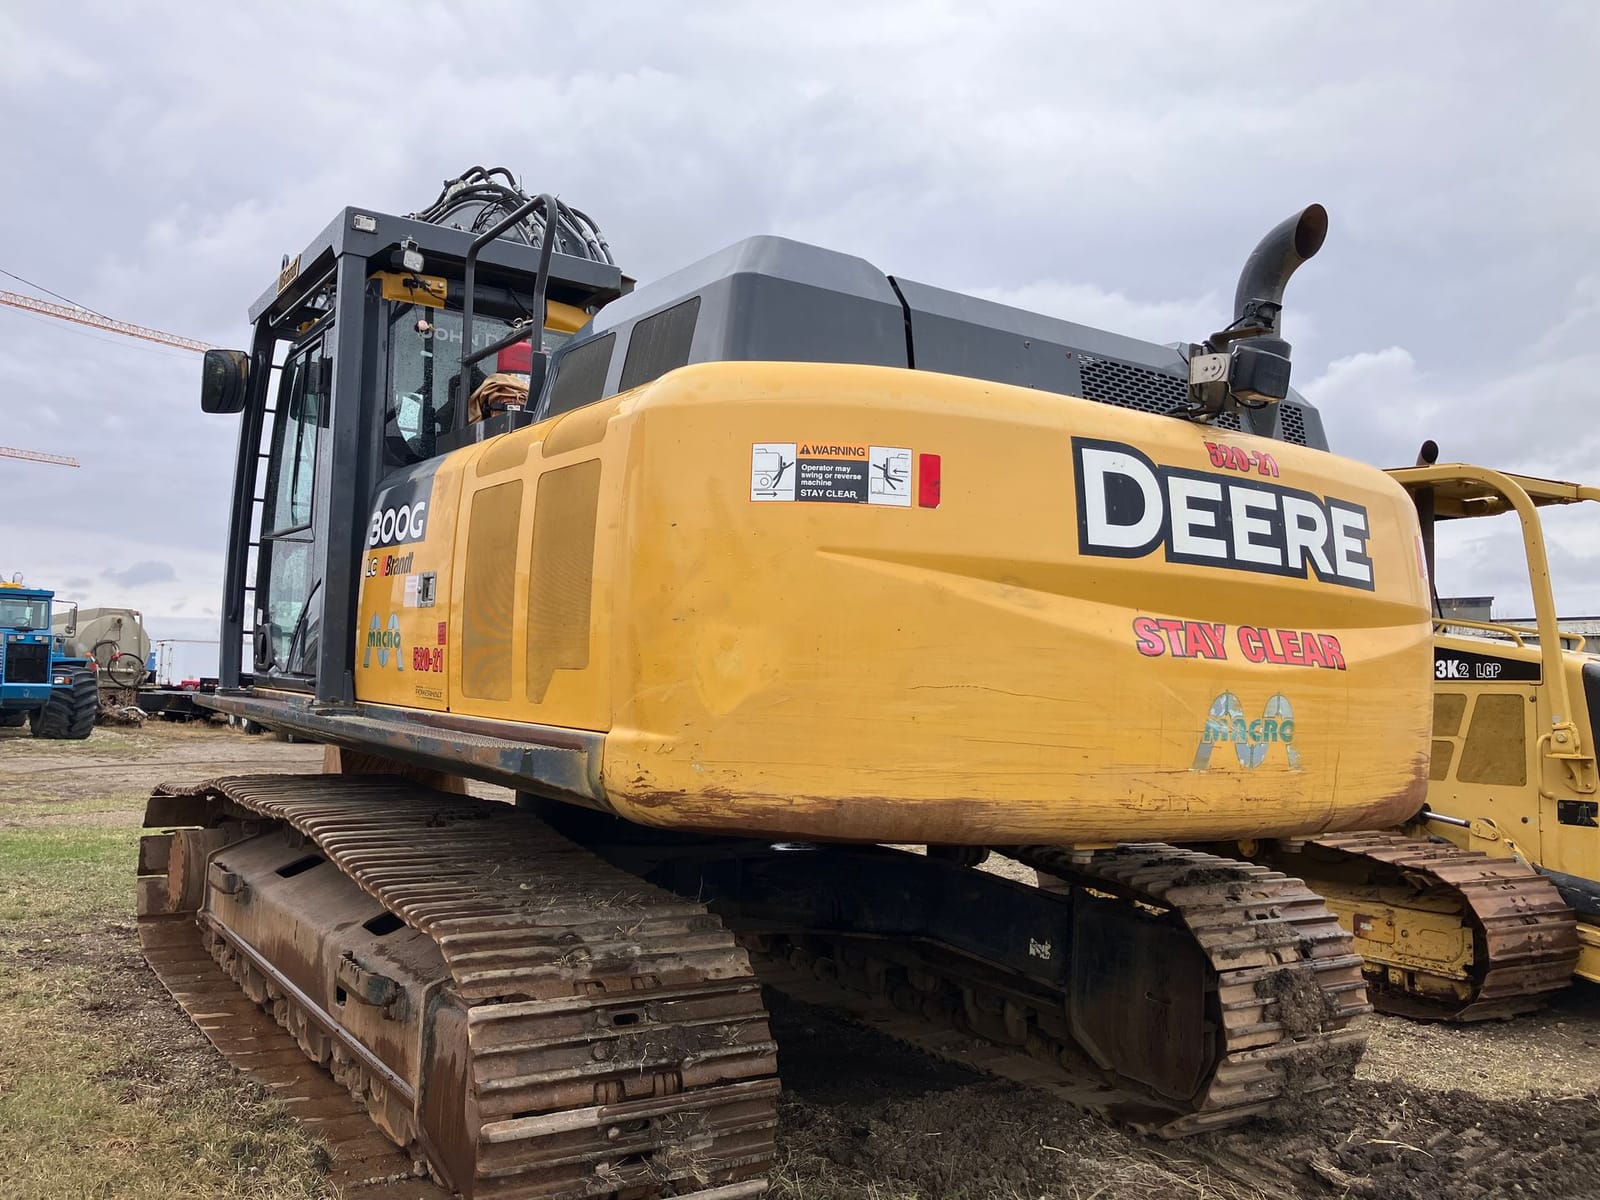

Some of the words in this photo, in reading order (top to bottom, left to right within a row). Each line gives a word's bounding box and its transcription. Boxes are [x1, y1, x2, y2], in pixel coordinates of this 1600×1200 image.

[812, 446, 865, 456] WARNING
[1204, 441, 1280, 478] 520-21
[801, 464, 833, 472] Operator
[800, 489, 825, 497] STAY
[825, 490, 857, 498] CLEAR
[369, 501, 426, 546] 300G
[1080, 447, 1372, 583] DEERE
[384, 552, 414, 577] Brandt
[367, 630, 402, 649] MACRO
[1132, 616, 1228, 661] STAY
[1236, 625, 1347, 672] CLEAR
[1475, 662, 1502, 678] LGP
[1203, 717, 1296, 744] MACRO
